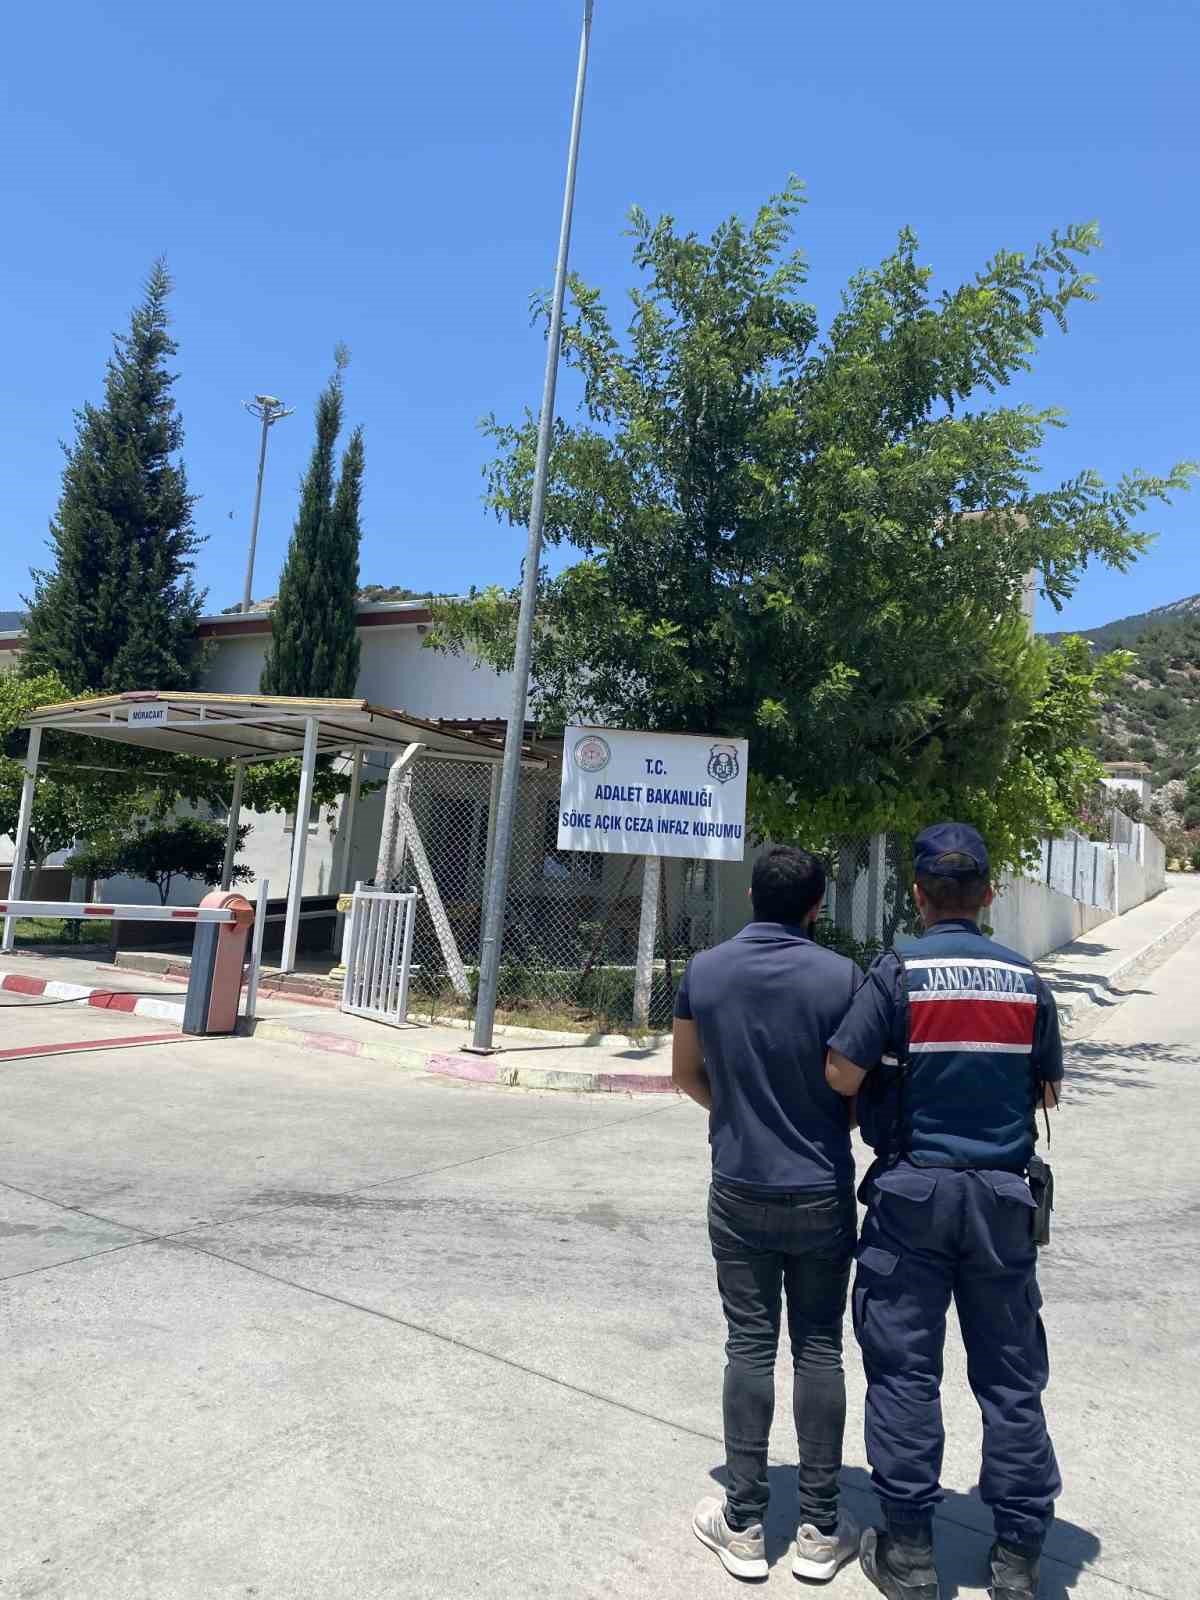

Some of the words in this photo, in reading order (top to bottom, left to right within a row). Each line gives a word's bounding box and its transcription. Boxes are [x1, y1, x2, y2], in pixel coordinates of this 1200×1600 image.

[645, 759, 667, 775] T.C.
[595, 785, 642, 803] ADALET
[646, 788, 713, 807] BAKANLIĞI
[562, 809, 592, 828] SÖKE
[594, 815, 621, 834] AÇIK
[625, 817, 654, 833] CEZA
[657, 816, 689, 835] İNFAZ
[692, 821, 742, 839] KURUMU
[922, 966, 1027, 993] JANDARMA
